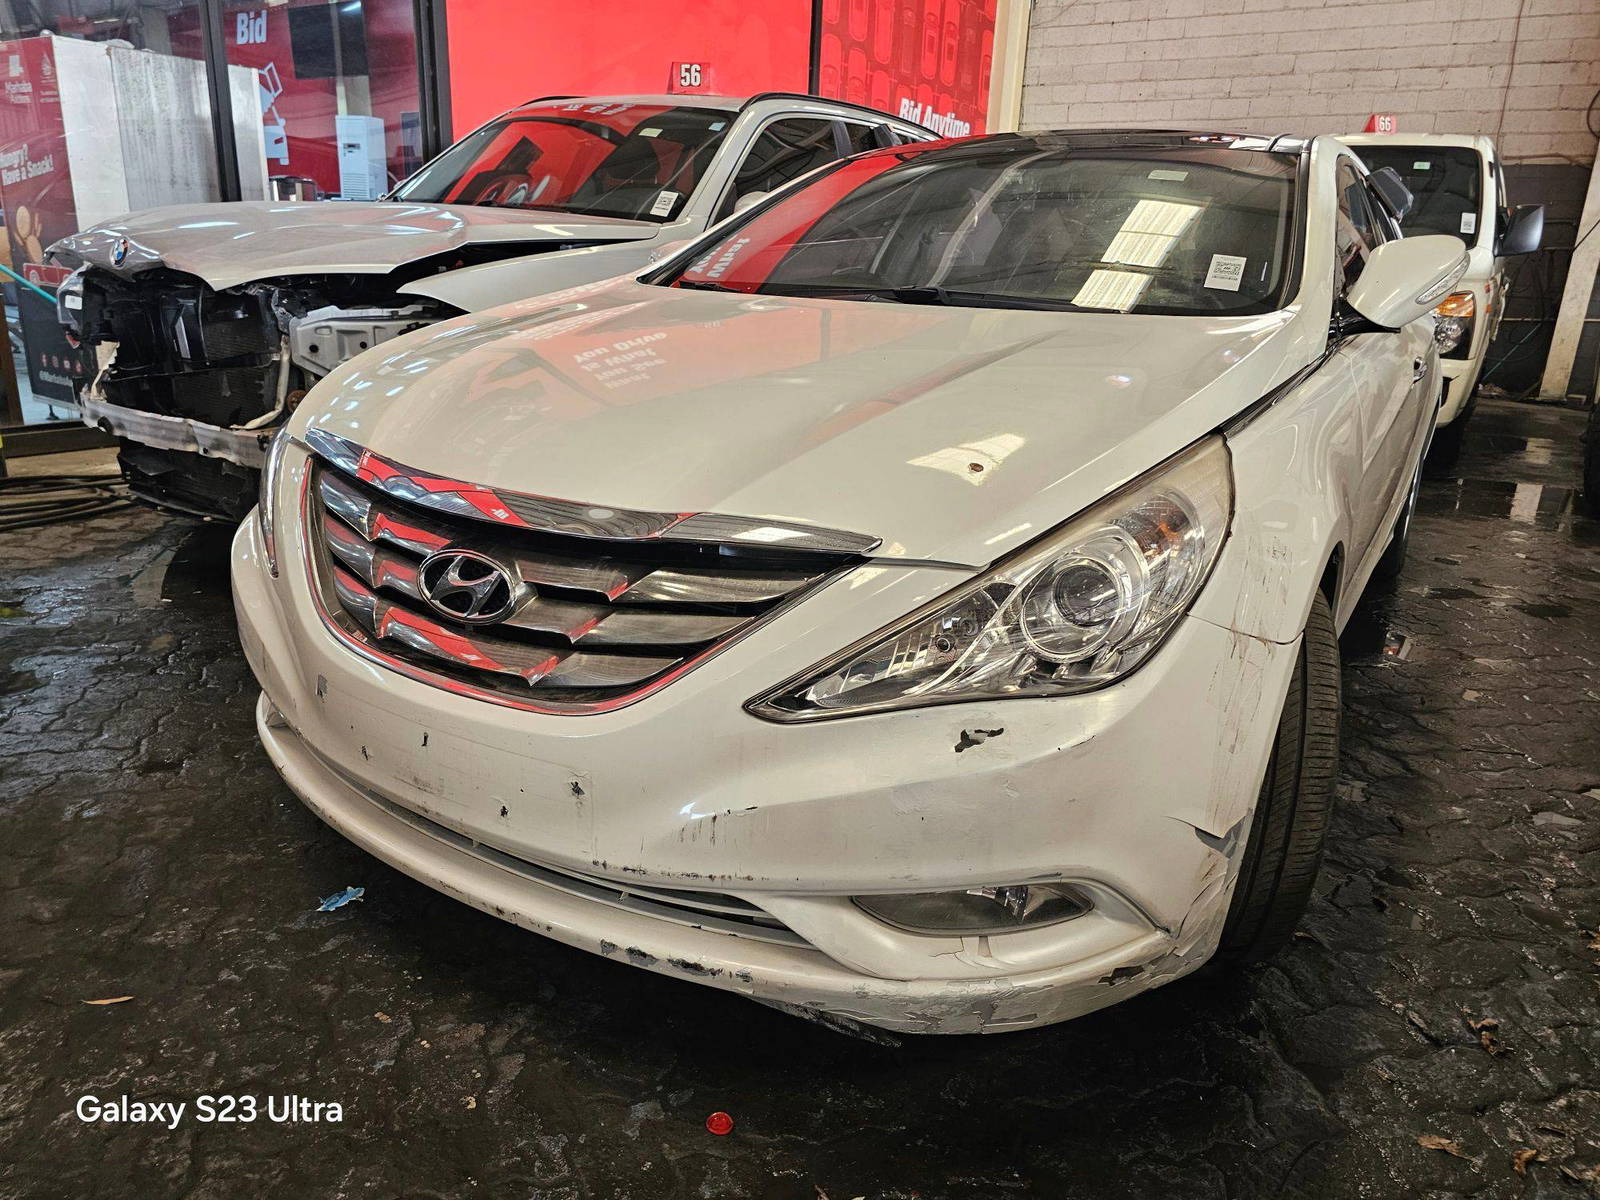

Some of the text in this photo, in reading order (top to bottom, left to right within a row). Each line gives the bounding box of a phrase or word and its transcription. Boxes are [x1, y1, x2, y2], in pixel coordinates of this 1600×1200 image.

[237, 10, 267, 44] Bid
[681, 63, 702, 87] 56
[899, 97, 971, 138] Bid Anytime
[1378, 115, 1391, 132] 66
